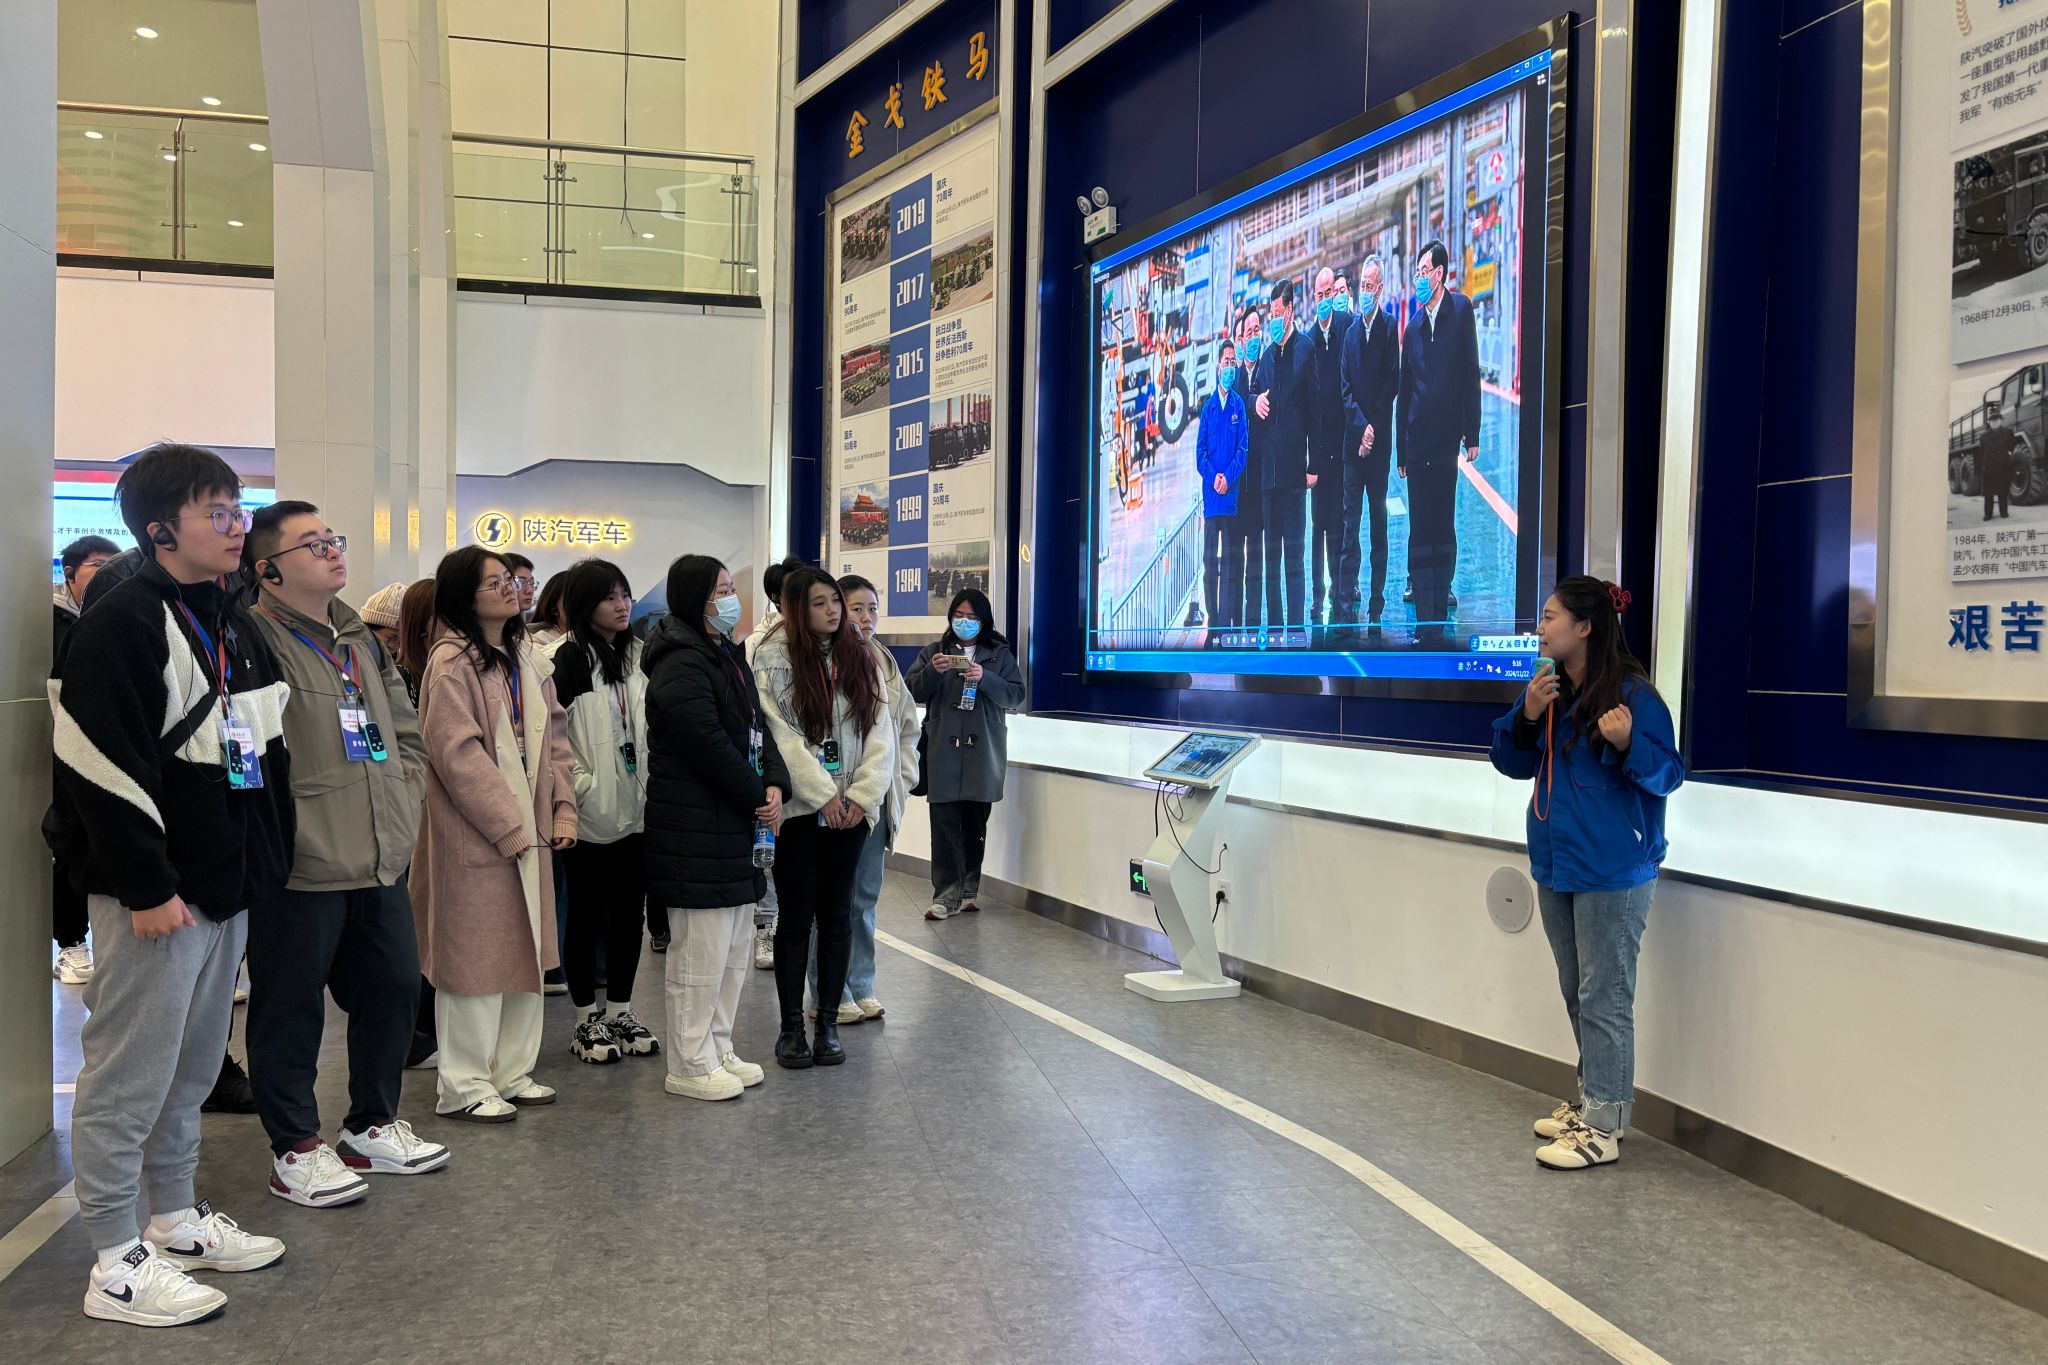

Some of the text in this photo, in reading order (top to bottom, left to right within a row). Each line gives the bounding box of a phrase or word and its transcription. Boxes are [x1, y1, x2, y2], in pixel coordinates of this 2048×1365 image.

[846, 31, 989, 158] 金戈铁马
[896, 198, 925, 235] 2019
[896, 272, 924, 307] 2017
[935, 341, 974, 361] 战争胜利70周年
[936, 329, 967, 349] 世界反法西斯
[896, 347, 923, 380] 2015
[896, 421, 923, 451] 2009
[933, 483, 944, 493] 国庆
[933, 494, 950, 506] 50周年
[895, 495, 922, 522] 1999
[523, 518, 628, 545] 陕汽军车
[895, 567, 921, 593] 1984
[1948, 601, 2044, 651] 艰苦
